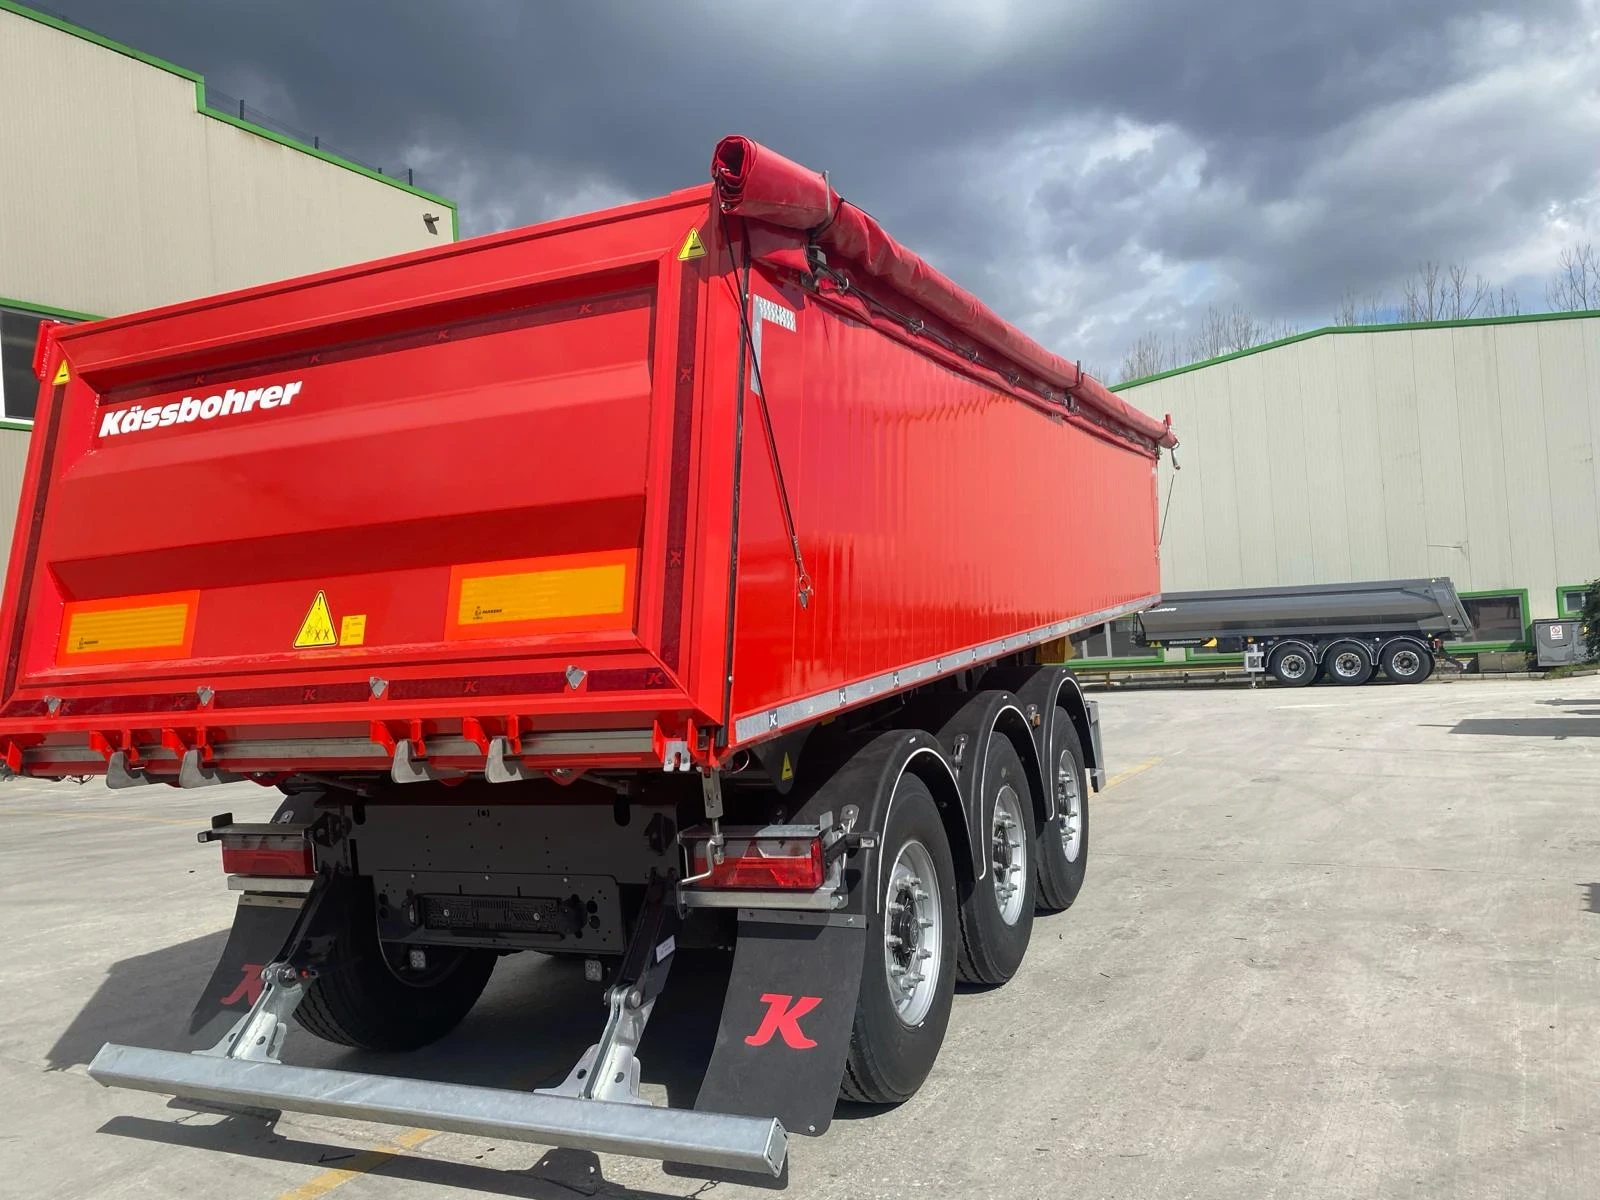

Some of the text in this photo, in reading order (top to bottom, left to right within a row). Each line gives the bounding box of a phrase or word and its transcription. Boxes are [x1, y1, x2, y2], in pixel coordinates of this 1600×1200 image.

[98, 380, 303, 438] Kässbohrer
[769, 713, 778, 728] K
[744, 993, 824, 1050] K
